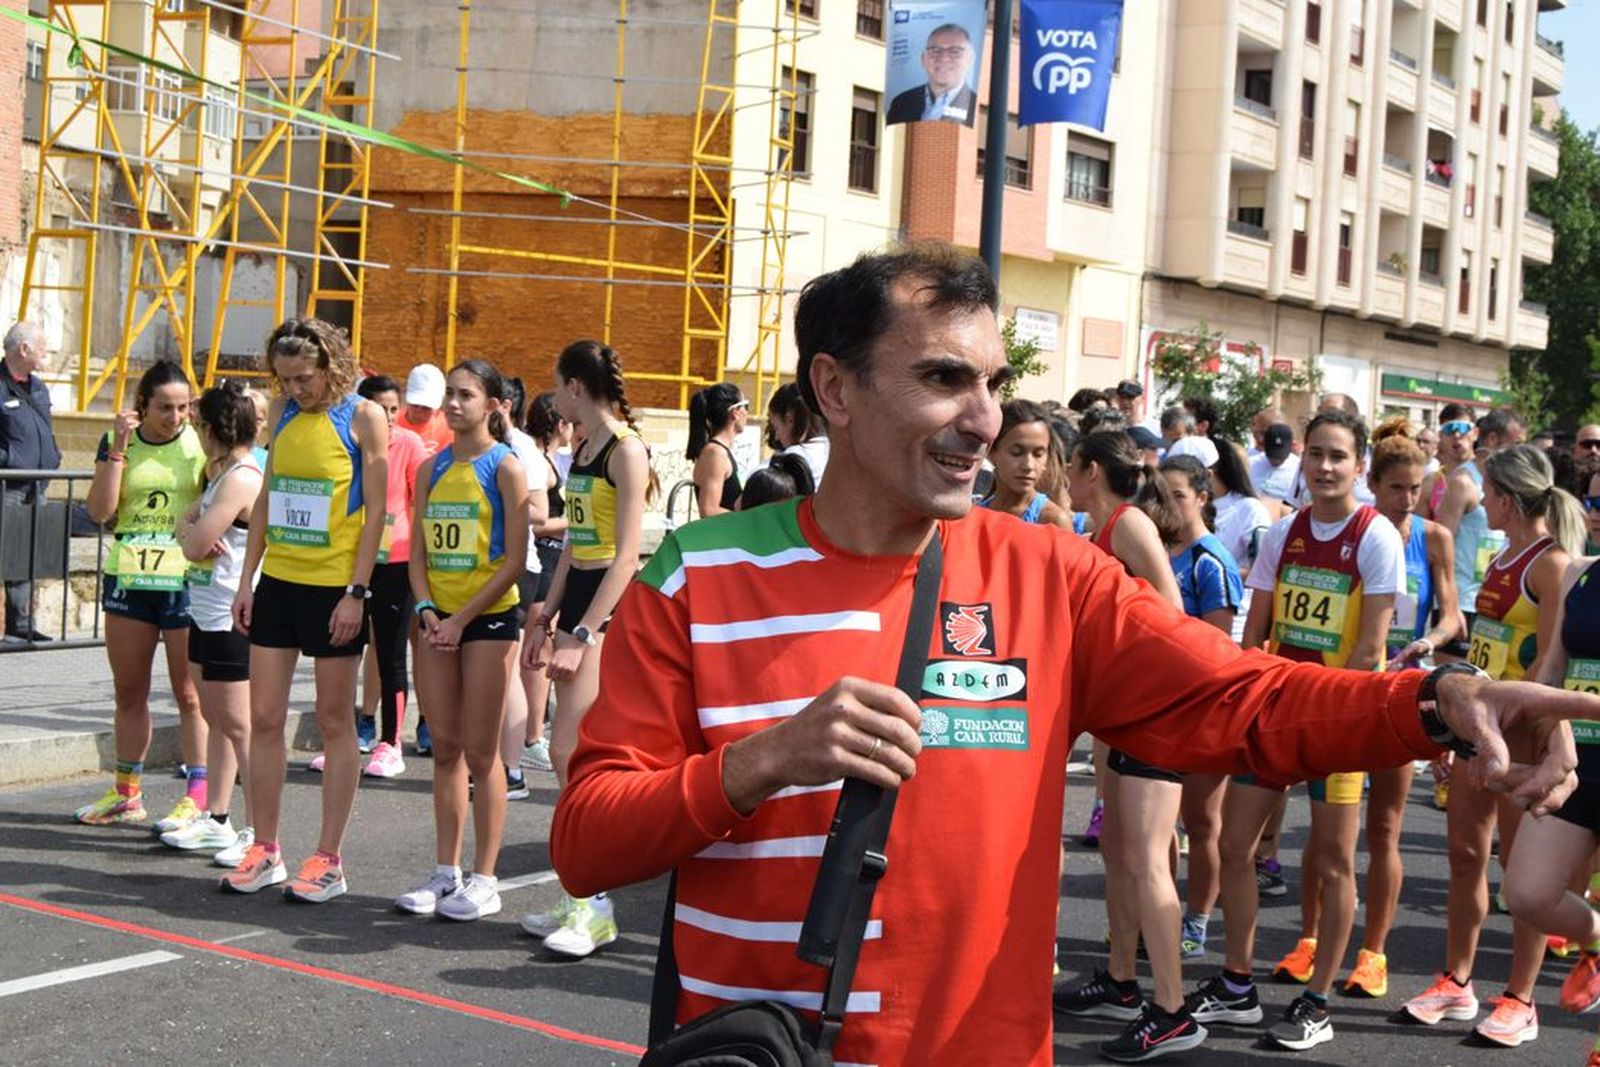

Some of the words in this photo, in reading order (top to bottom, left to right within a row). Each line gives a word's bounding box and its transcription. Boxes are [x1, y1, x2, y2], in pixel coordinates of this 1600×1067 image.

[1036, 28, 1097, 49] VOTA
[433, 522, 460, 549] 30
[137, 548, 165, 571] 17
[1283, 589, 1331, 626] 184
[954, 731, 987, 743] CAJA
[989, 732, 1025, 745] RURAL
